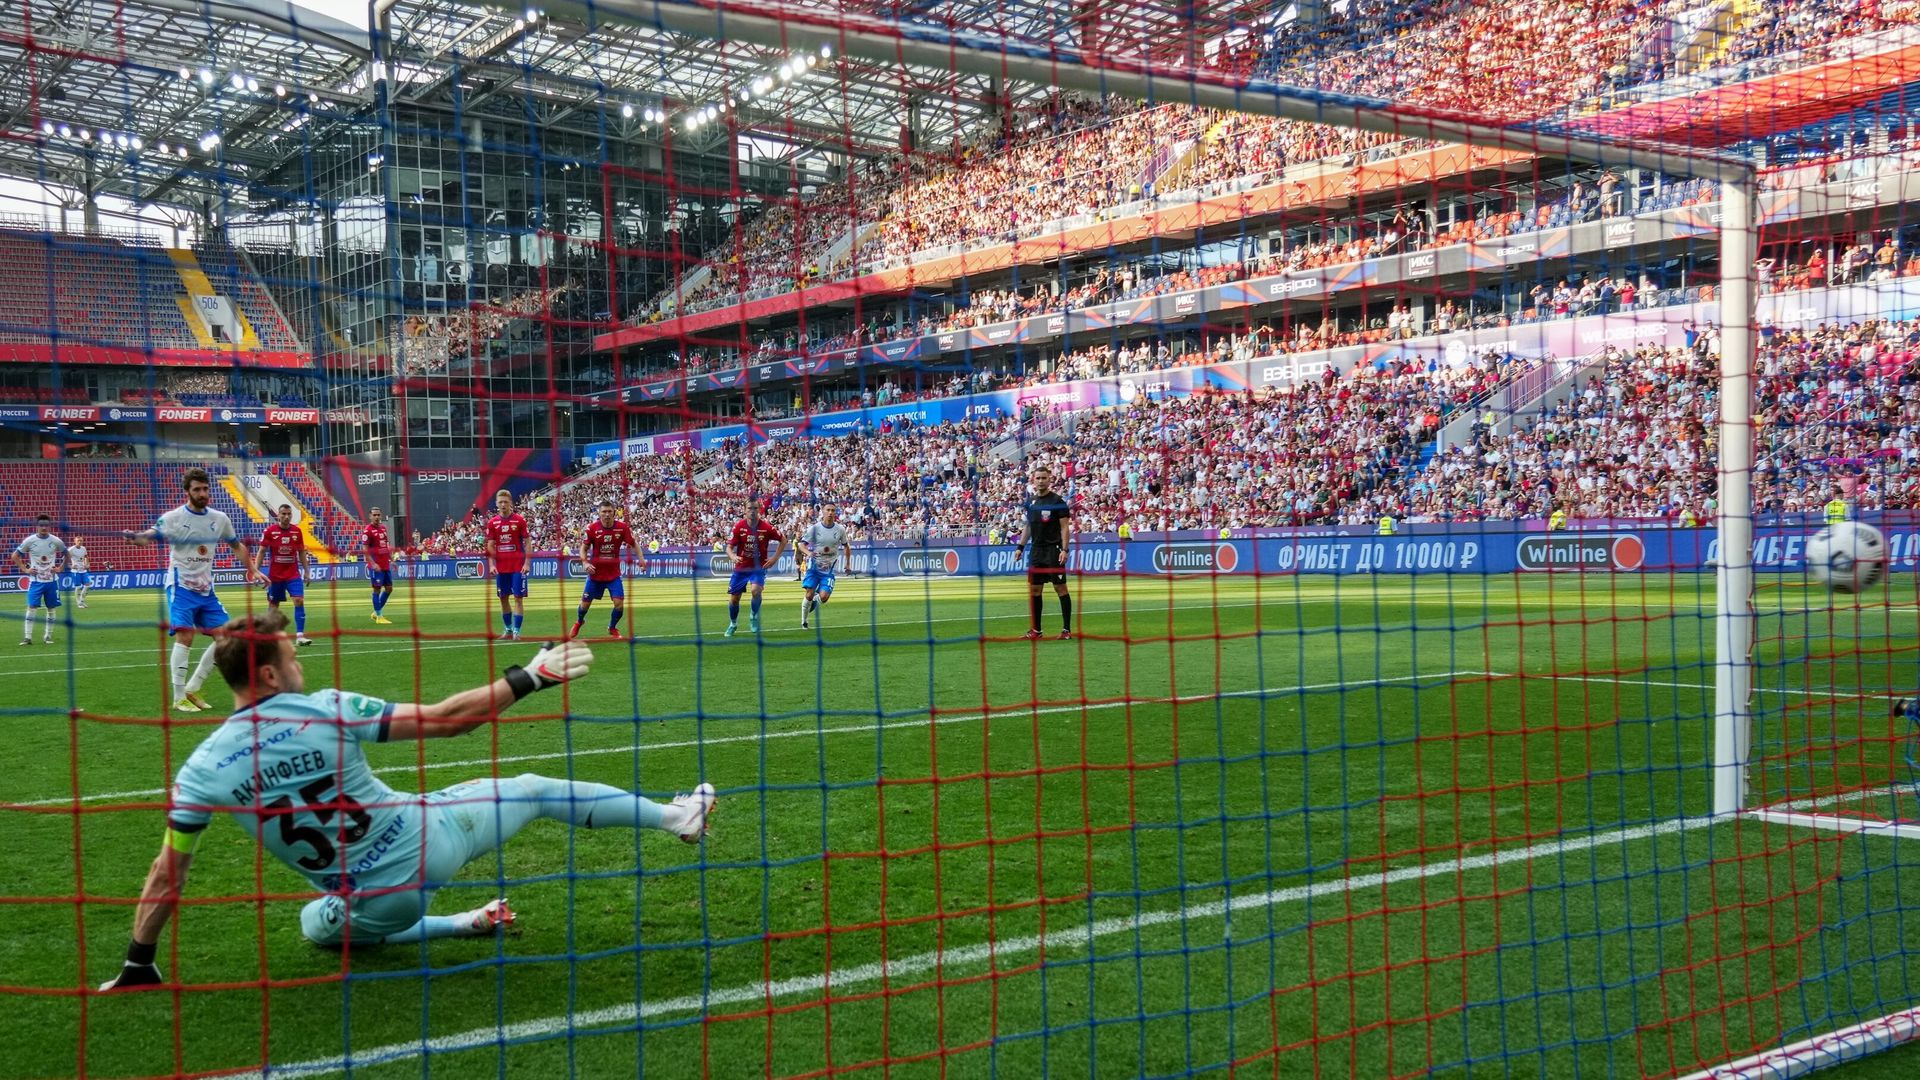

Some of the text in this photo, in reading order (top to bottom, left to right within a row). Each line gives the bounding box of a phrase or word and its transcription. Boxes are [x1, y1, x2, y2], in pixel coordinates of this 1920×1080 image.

[1610, 221, 1635, 236] ИКС
[1411, 255, 1434, 268] ИКС
[202, 297, 218, 310] 506
[44, 408, 95, 419] FONBET
[159, 409, 207, 420] FONBET
[270, 411, 315, 421] FONBET
[974, 404, 990, 414] ПСБ
[1069, 549, 1111, 571] 10000
[1159, 551, 1213, 567] Winline
[1278, 544, 1351, 570] ФРИБЕТ
[1356, 543, 1385, 573] ДО
[1396, 542, 1455, 569] 10000
[1527, 544, 1608, 563] Winline
[650, 559, 661, 578] ДО
[664, 558, 689, 575] 10000
[903, 556, 942, 570] Winline
[112, 574, 129, 589] ДО
[232, 749, 326, 806] АКИНФЕЕВ
[261, 774, 372, 871] 35
